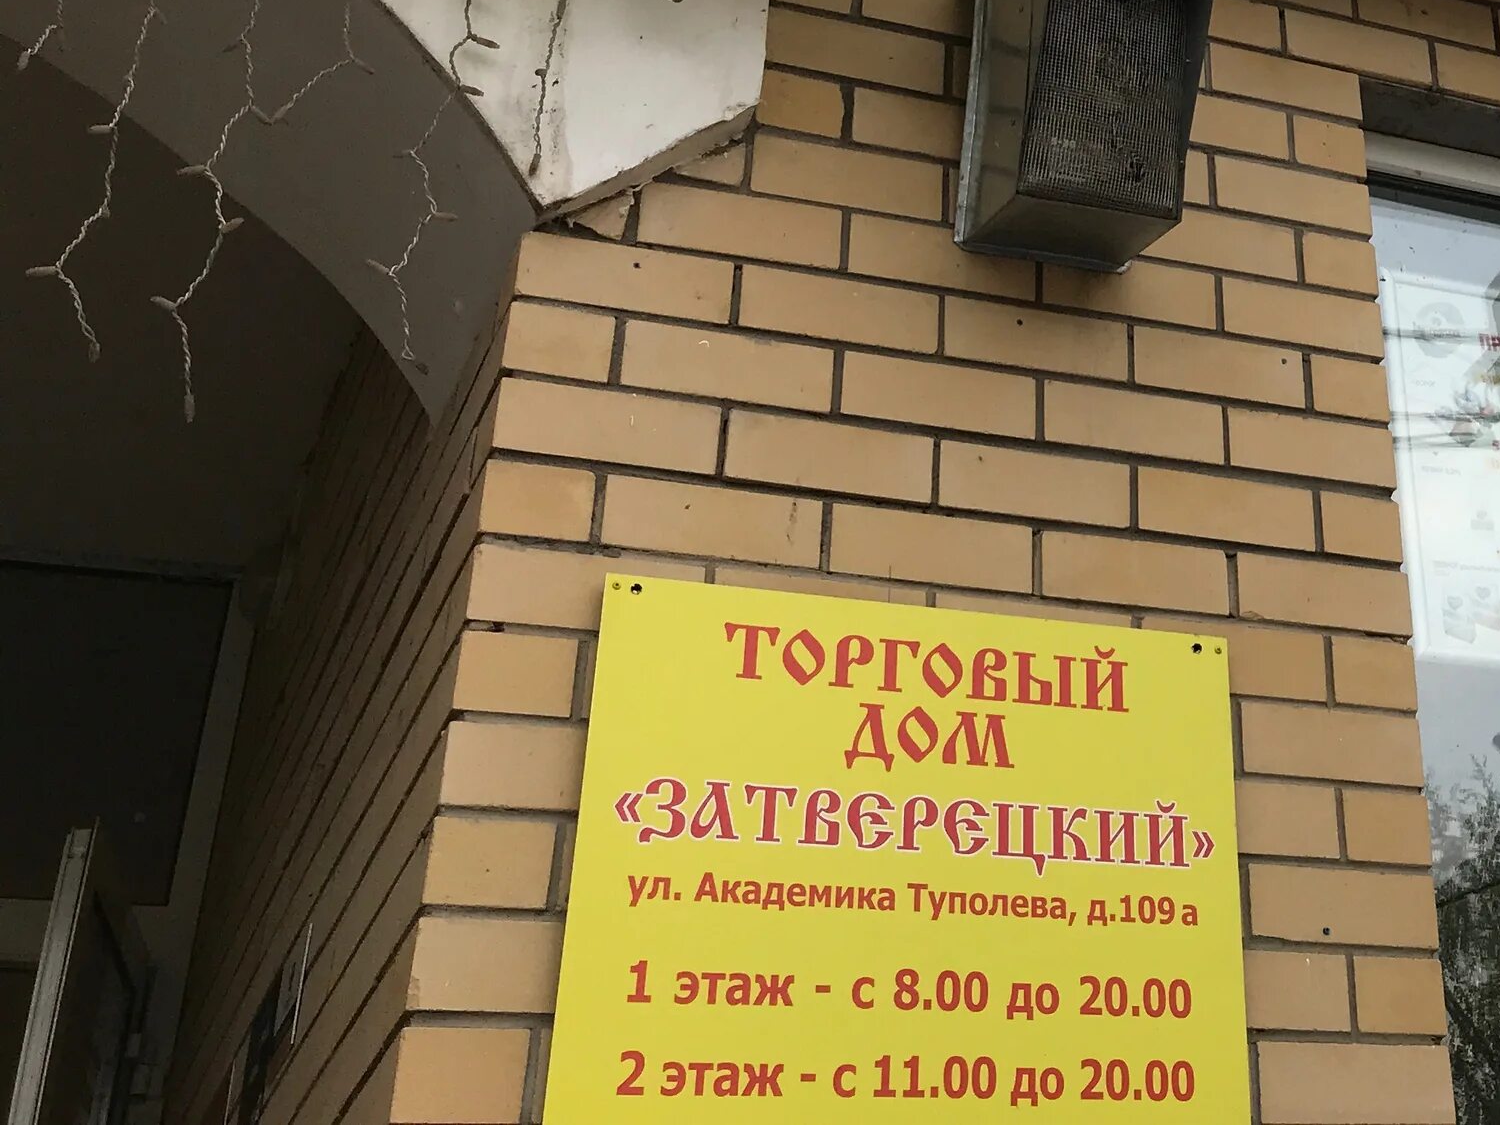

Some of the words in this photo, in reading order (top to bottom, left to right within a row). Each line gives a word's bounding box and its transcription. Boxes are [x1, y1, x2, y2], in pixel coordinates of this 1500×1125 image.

[724, 622, 1129, 713] ТОРГОВЫЙ
[844, 703, 1015, 772] ДОМ
[627, 874, 682, 907] ул.
[694, 872, 896, 912] Академика
[907, 883, 1078, 928] Туполева,
[626, 960, 652, 1004] 1
[674, 968, 795, 1009] этаж
[851, 977, 875, 1010] с
[893, 969, 989, 1014] 8.00
[1006, 982, 1060, 1020] до
[1078, 975, 1193, 1020] 20.00
[615, 1050, 647, 1097] 2
[660, 1059, 785, 1099] этаж
[831, 1066, 857, 1100] с
[872, 1055, 998, 1101] 11.00
[1010, 1069, 1065, 1108] до
[1079, 1059, 1197, 1104] 20.00
